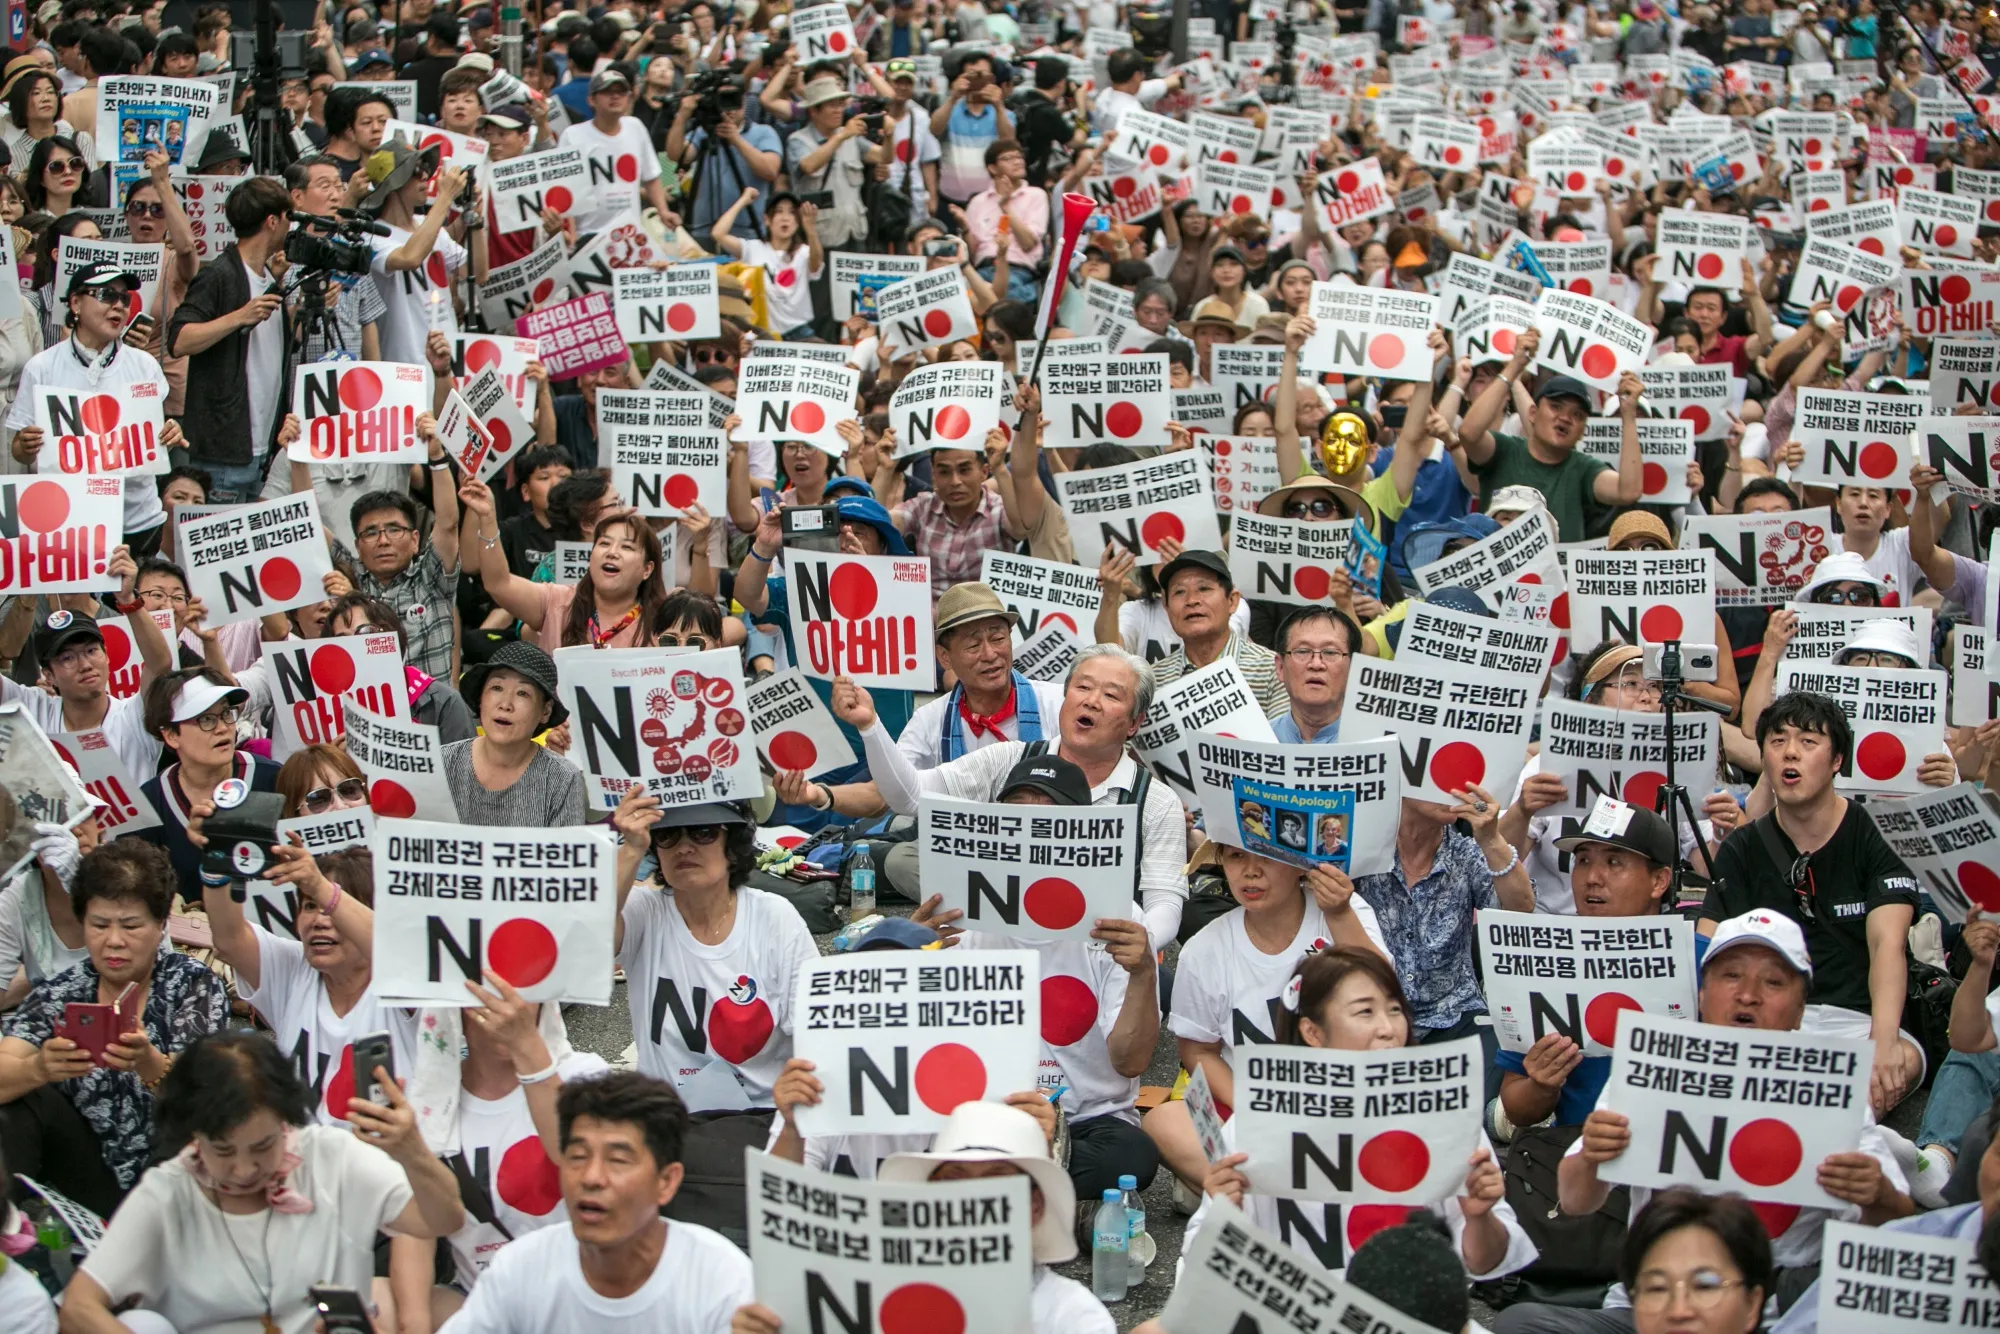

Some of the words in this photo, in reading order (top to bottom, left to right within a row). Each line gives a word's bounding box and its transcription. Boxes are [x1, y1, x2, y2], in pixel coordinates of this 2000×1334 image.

[105, 82, 156, 97] 토착왜구
[162, 82, 212, 102] 몰아내자
[492, 160, 536, 182] 아베정권
[539, 149, 582, 167] 규탄한다
[496, 173, 540, 192] 강제징용
[542, 162, 585, 182] 사죄하라
[123, 251, 159, 265] 규탄한다
[619, 273, 663, 286] 토착왜구
[666, 269, 710, 283] 몰아내자
[620, 286, 662, 300] 조선일보
[666, 283, 711, 298] 폐간하라
[1318, 289, 1372, 309] 아베정권
[1377, 296, 1432, 315] 규탄한다
[1316, 306, 1371, 324] 강제징용
[1375, 313, 1430, 331] 사죄하라
[1542, 306, 1593, 330] 강제징용
[1547, 294, 1598, 316] 아베정권
[1602, 309, 1646, 342] 규탄한다
[1939, 359, 1992, 373] 강제징용
[1940, 345, 1993, 360] 아베정권
[746, 365, 795, 377] 아베정권
[800, 366, 850, 387] 규탄한다
[898, 370, 938, 393] 아베정권
[941, 367, 995, 383] 규탄한다
[1048, 363, 1101, 378] 토착왜구
[1107, 361, 1162, 376] 몰아내자
[745, 380, 793, 393] 강제징용
[797, 382, 848, 402] 사죄하라
[894, 387, 937, 409] 강제징용
[939, 384, 993, 399] 사죄하라
[1048, 379, 1101, 395] 조선일보
[1107, 379, 1162, 394] 폐간하라
[602, 394, 651, 409] 아베정권
[655, 397, 702, 411] 규탄한다
[1804, 395, 1860, 412] 아베정권
[1864, 400, 1922, 417] 규탄한다
[310, 405, 414, 459] 아베!
[602, 410, 650, 425] 강제징용
[654, 413, 702, 428] 사죄하라
[1803, 414, 1859, 435] 강제징용
[58, 421, 156, 474] 아베!
[617, 435, 664, 449] 토착왜구
[667, 436, 719, 450] 몰아내자
[617, 451, 663, 466] 조선일보
[666, 452, 719, 467] 폐간하라
[1064, 470, 1129, 496] 아베정권
[1132, 456, 1198, 485] 규탄한다
[1070, 492, 1132, 515] 강제징용
[1137, 478, 1202, 504] 사죄하라
[188, 515, 243, 547] 토착왜구
[248, 501, 309, 531] 몰아내자
[1236, 517, 1293, 537] 토착왜구
[1297, 524, 1351, 544] 몰아내자
[192, 538, 248, 568] 조선일보
[253, 522, 314, 551] 폐간하라
[1235, 534, 1292, 555] 조선일보
[1425, 551, 1486, 588] 토착왜구
[1489, 514, 1542, 559] 몰아내자
[1497, 533, 1549, 577] 폐간하라
[893, 562, 927, 572] 아베규탄
[893, 572, 927, 583] 시민행동
[989, 558, 1046, 581] 토착왜구
[1575, 558, 1637, 575] 아베정권
[1643, 558, 1706, 575] 규탄한다
[988, 576, 1043, 599] 조선일보
[1576, 578, 1638, 596] 강제징용
[1643, 579, 1706, 596] 사죄하라
[365, 637, 395, 646] 아베규탄
[807, 615, 916, 676] 아베!
[1413, 613, 1483, 639] 토착왜구
[1486, 628, 1548, 654] 몰아내자
[366, 645, 397, 654] 시민행동
[1407, 634, 1475, 665] 조선일보
[1480, 650, 1542, 675] 폐간하라
[640, 667, 665, 676] JAPAN
[1360, 666, 1443, 700] 아베정권
[1451, 681, 1528, 710] 규탄한다
[1788, 672, 1859, 696] 아베정권
[1866, 678, 1937, 701] 규탄한다
[1356, 692, 1438, 726] 강제징용
[1443, 708, 1523, 735] 사죄하라
[1551, 712, 1625, 738] 아베정권
[1862, 701, 1936, 724] 사죄하라
[372, 724, 429, 752] 규탄한다
[372, 748, 434, 773] 사죄하라
[1199, 742, 1285, 776] 아베정권
[1293, 751, 1387, 777] 규탄한다
[1243, 784, 1260, 798] We
[1261, 788, 1288, 803] want
[1290, 793, 1339, 810] Apology
[931, 809, 1022, 837] 토착왜구
[1031, 818, 1124, 840] 몰아내자
[389, 836, 483, 866] 아베정권
[492, 842, 598, 869] 규탄한다
[931, 833, 1021, 862] 조선일보
[1029, 844, 1123, 868] 폐간하라
[388, 871, 483, 901] 강제징용
[492, 877, 598, 903] 사죄하라
[1489, 923, 1573, 952] 아베정권
[1581, 927, 1672, 952] 규탄한다
[1493, 952, 1577, 979] 강제징용
[1584, 955, 1676, 980] 사죄하라
[808, 966, 908, 998] 토착왜구
[918, 965, 1024, 993] 몰아내자
[808, 1000, 908, 1031] 조선일보
[918, 999, 1025, 1029] 폐간하라
[1629, 1026, 1739, 1067] 아베정권
[1748, 1042, 1857, 1077] 규탄한다
[1248, 1056, 1355, 1089] 아베정권
[1365, 1054, 1470, 1087] 규탄한다
[1626, 1060, 1735, 1099] 강제징용
[1742, 1076, 1853, 1109] 사죄하라
[1249, 1088, 1355, 1118] 강제징용
[1363, 1084, 1470, 1119] 사죄하라
[760, 1171, 870, 1225] 토착왜구
[880, 1195, 1012, 1231] 몰아내자
[760, 1207, 872, 1262] 조선일보
[881, 1234, 1013, 1267] 폐간하라
[1215, 1221, 1337, 1310] 토착왜구
[1838, 1240, 1958, 1285] 아베정권
[1206, 1248, 1322, 1334] 조선일보
[1835, 1279, 1951, 1324] 강제징용
